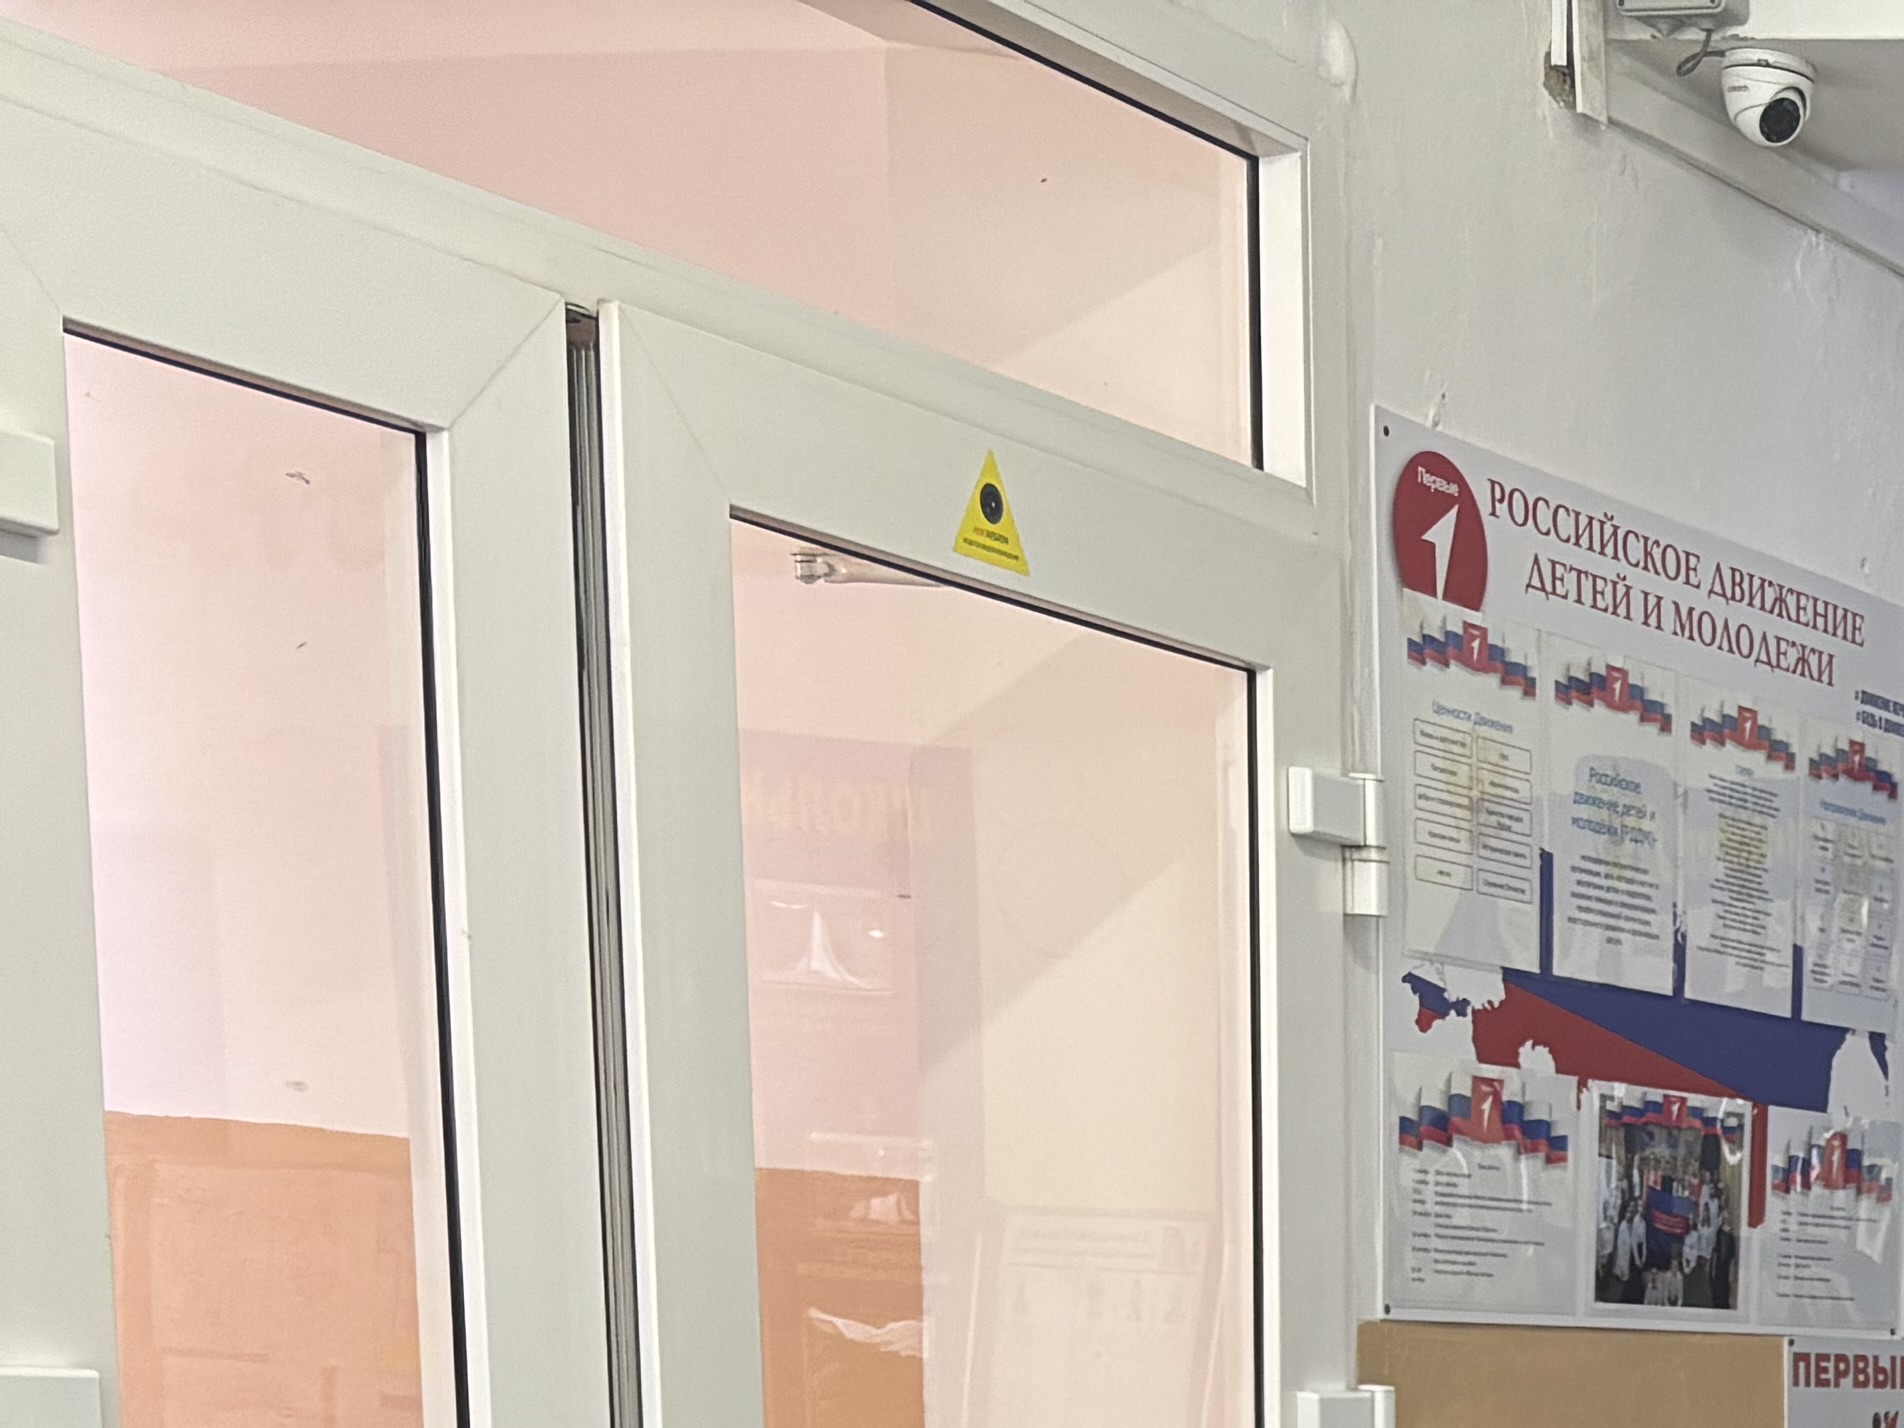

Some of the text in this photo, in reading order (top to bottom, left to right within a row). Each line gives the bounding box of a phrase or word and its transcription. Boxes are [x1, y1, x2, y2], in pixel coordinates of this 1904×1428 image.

[1487, 478, 1866, 648] РОССИЙСКОЕ ДВИЖЕНИЕ
[1525, 552, 1837, 688] ДЕТЕЙ И МОЛОДЕЖИ
